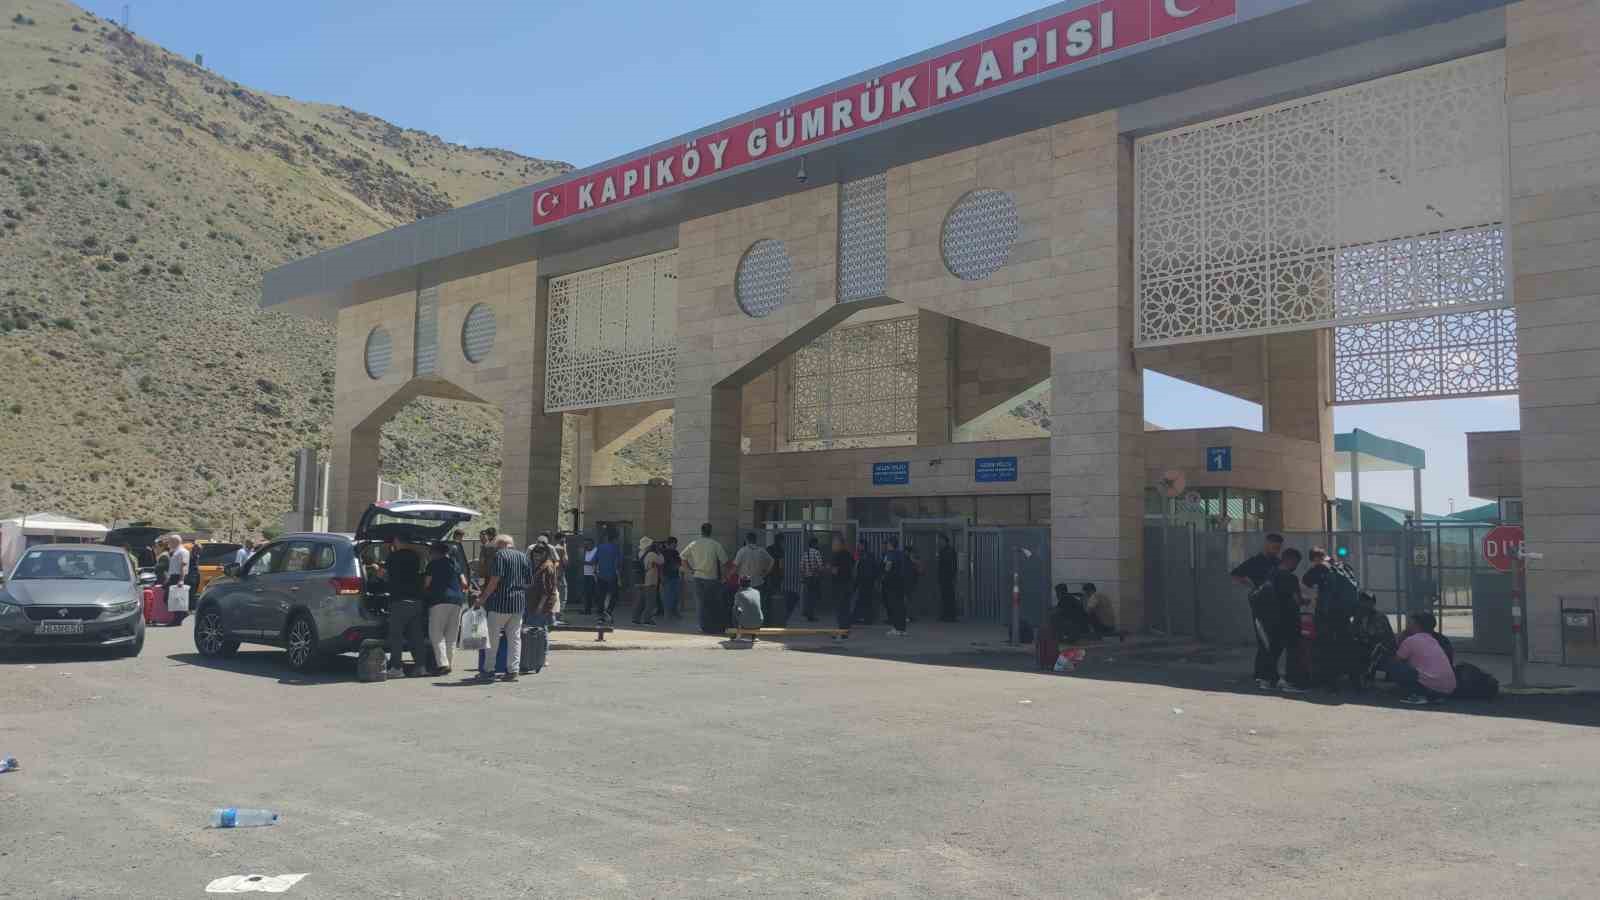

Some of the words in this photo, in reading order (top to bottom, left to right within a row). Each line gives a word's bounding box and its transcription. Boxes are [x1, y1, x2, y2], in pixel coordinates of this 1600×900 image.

[578, 139, 729, 209] KAPIKÖY
[747, 75, 918, 156] GÜMRÜK
[936, 10, 1114, 99] KAPISI
[1213, 454, 1223, 469] 1
